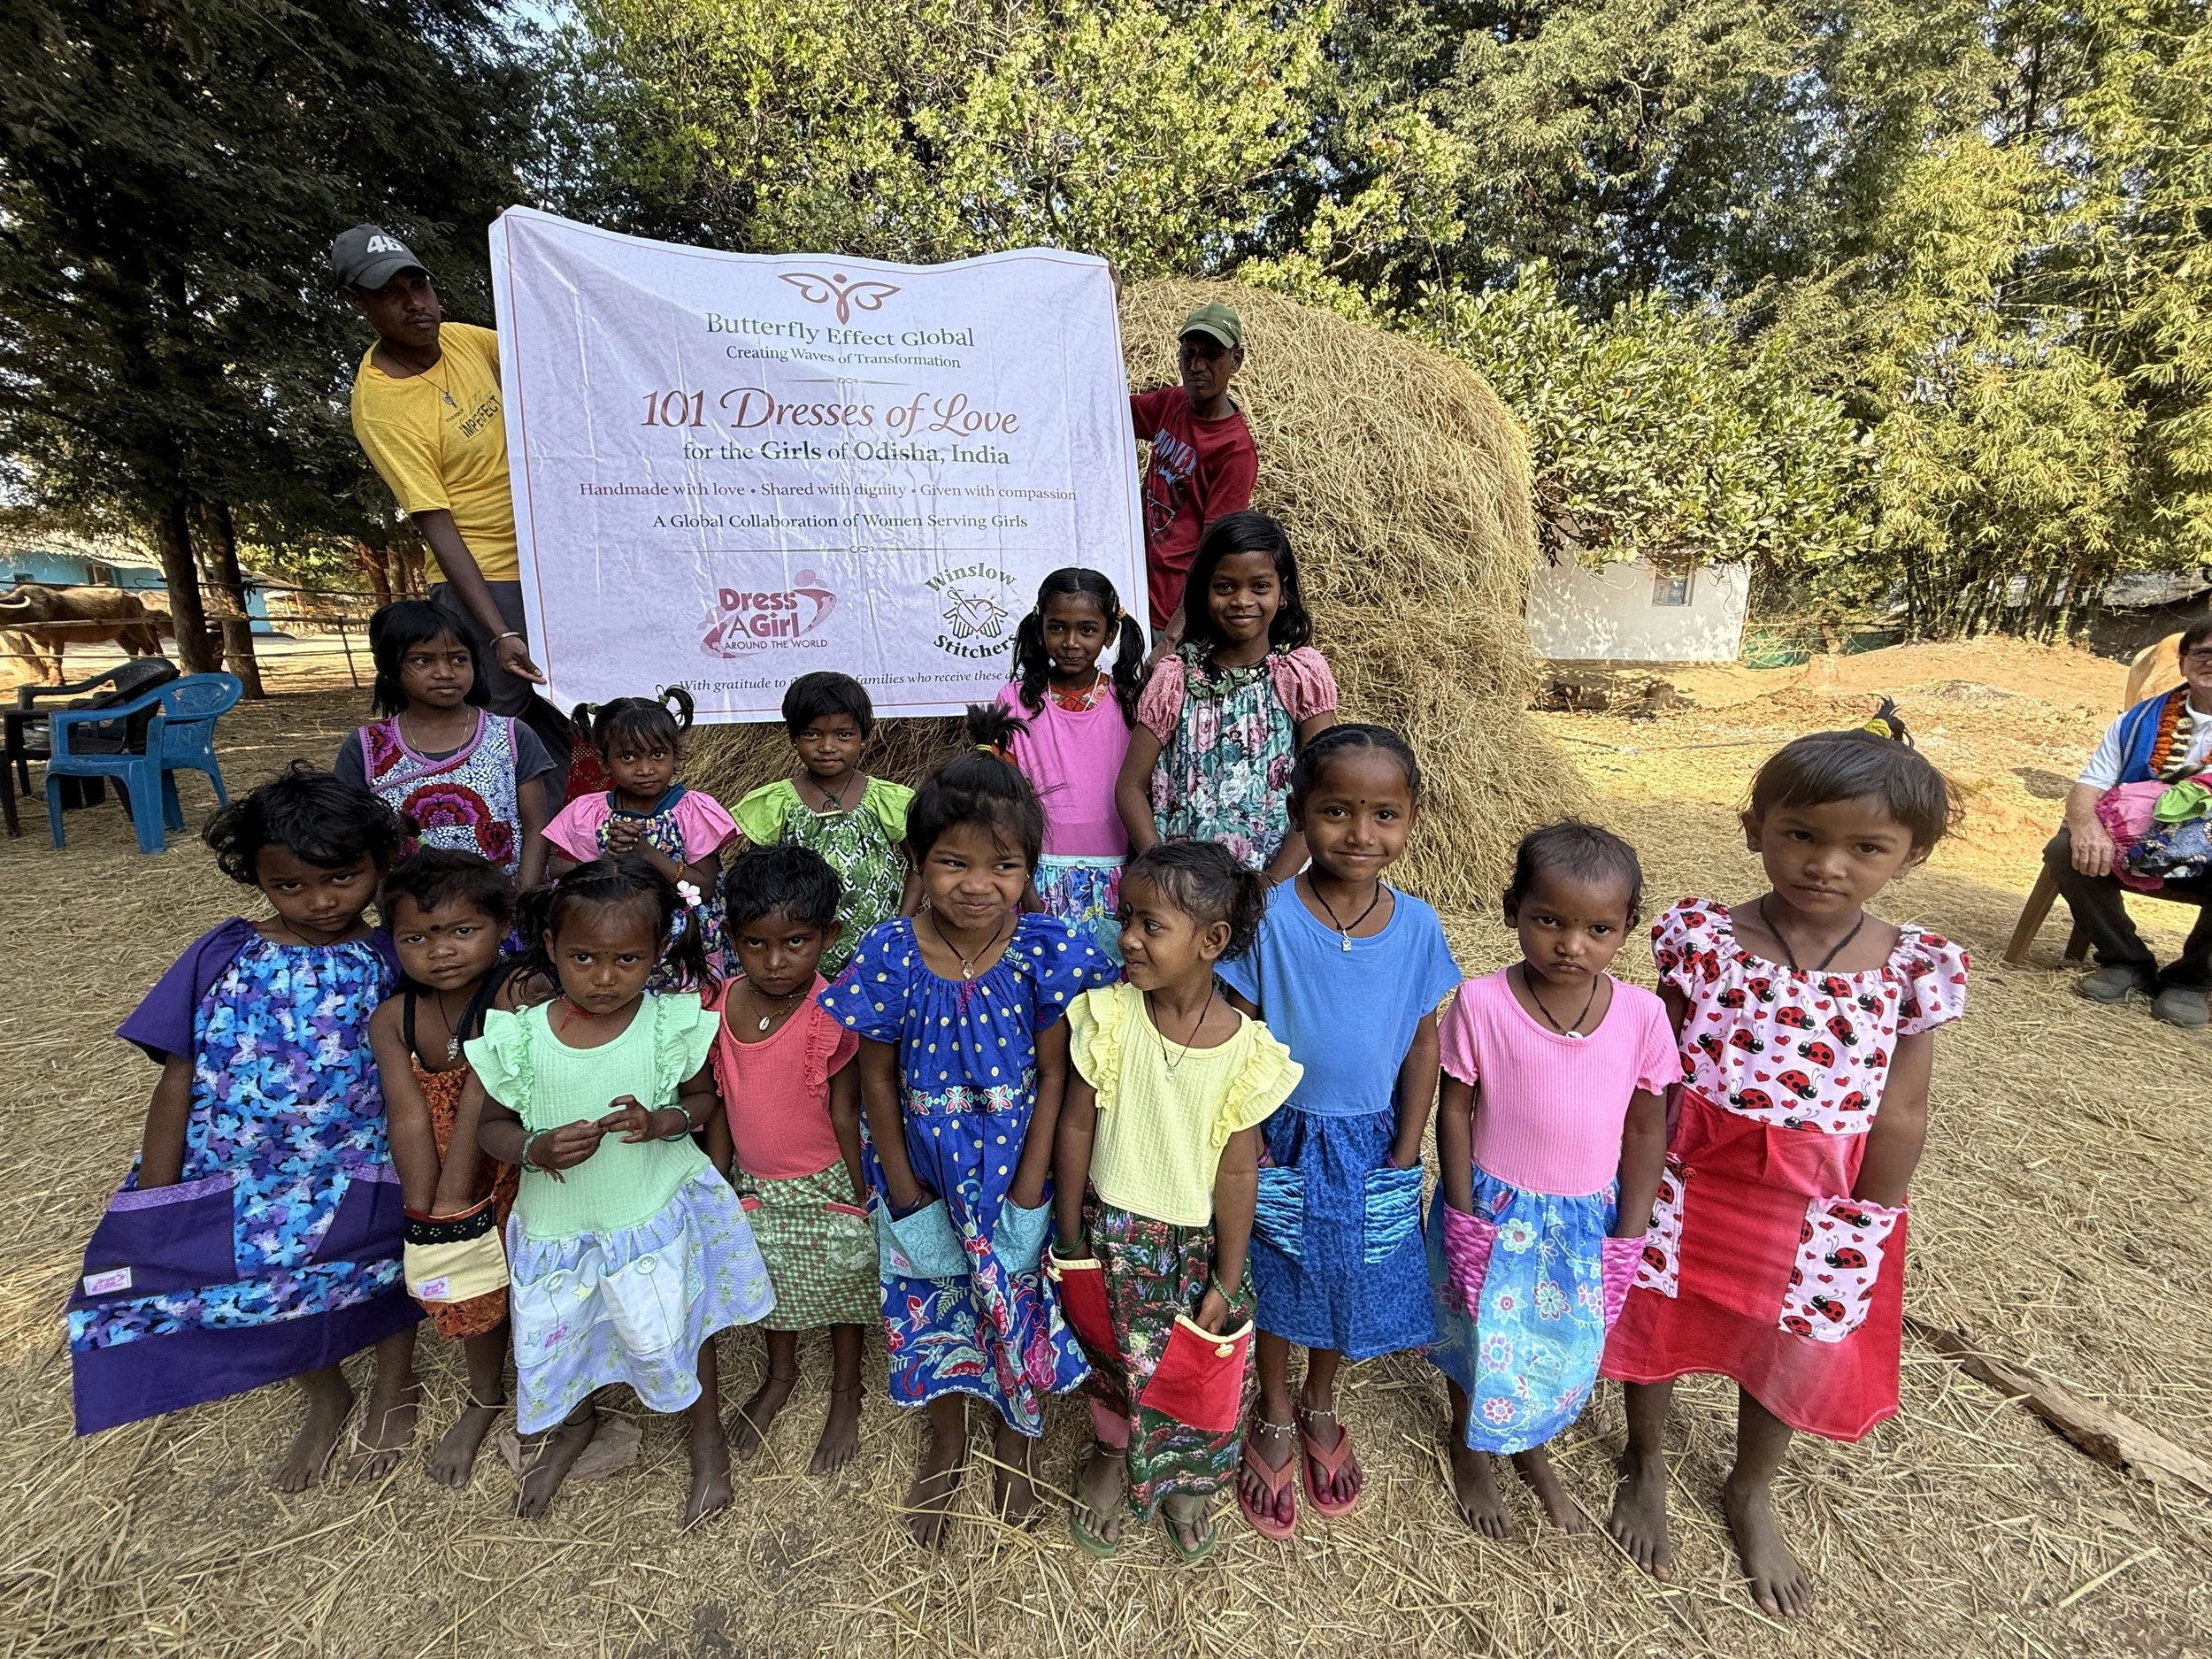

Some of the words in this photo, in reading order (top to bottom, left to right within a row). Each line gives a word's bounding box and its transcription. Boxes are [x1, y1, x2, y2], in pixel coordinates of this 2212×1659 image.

[366, 234, 404, 254] 46
[706, 312, 820, 345] Butterfly
[826, 326, 895, 346] Effect
[901, 327, 975, 347] Global
[726, 345, 789, 363] Creating
[790, 348, 835, 363] Waves
[838, 353, 852, 365] of
[854, 353, 962, 368] Transformation
[457, 395, 502, 439] IMPEFECT
[640, 388, 707, 427] 101
[719, 387, 875, 429] Dresses
[885, 391, 931, 439] of
[928, 392, 1021, 437] Love
[683, 442, 714, 460] for
[720, 442, 754, 461] the
[760, 441, 822, 461] Girls
[827, 442, 849, 461] of
[853, 441, 945, 465] Odisha,
[950, 444, 1011, 465] India
[580, 482, 669, 496] Handmade
[672, 482, 709, 495] with
[713, 482, 745, 495] love
[761, 482, 814, 495] Shared
[817, 482, 850, 495] with
[854, 482, 907, 499] dignity
[919, 484, 962, 496] Given
[964, 485, 996, 497] with
[998, 488, 1077, 502] compassion
[652, 514, 667, 528] A
[670, 514, 725, 528] Global
[728, 513, 839, 528] Collaboration
[842, 513, 859, 527] of
[862, 514, 923, 527] Women
[927, 514, 987, 531] Serving
[991, 514, 1028, 528] Girls
[925, 562, 1018, 592] Winslow
[718, 588, 798, 611] Dress
[724, 640, 768, 650] AROUND
[770, 640, 788, 649] THE
[790, 639, 828, 649] WORLD
[933, 634, 1017, 658] Stitchers
[680, 679, 710, 691] With
[713, 677, 772, 694] gratitude
[773, 678, 787, 688] to
[855, 672, 905, 686] families
[907, 672, 930, 683] who
[934, 671, 972, 683] receive
[974, 670, 1004, 681] these
